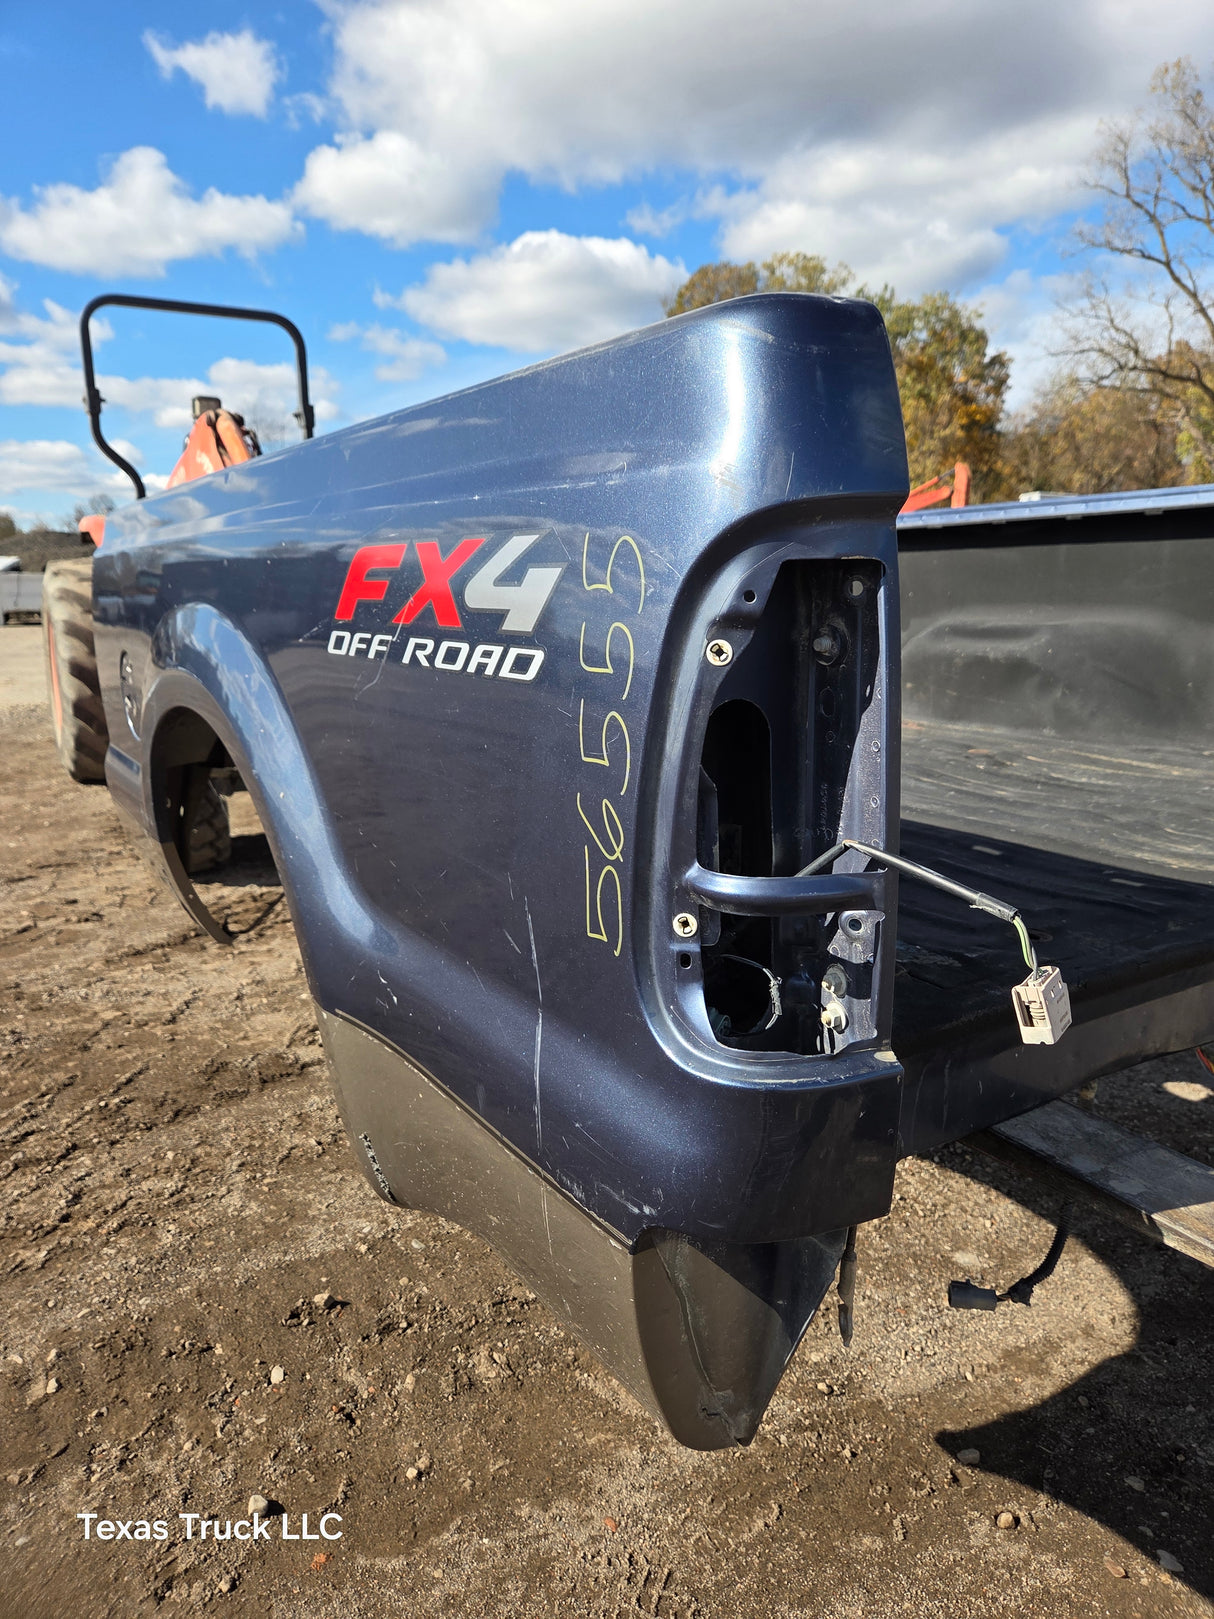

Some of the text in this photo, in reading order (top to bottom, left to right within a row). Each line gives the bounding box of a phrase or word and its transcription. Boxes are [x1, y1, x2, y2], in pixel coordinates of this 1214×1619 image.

[335, 534, 562, 632] FX4
[327, 630, 545, 681] OFF ROAD
[577, 532, 645, 957] 56555
